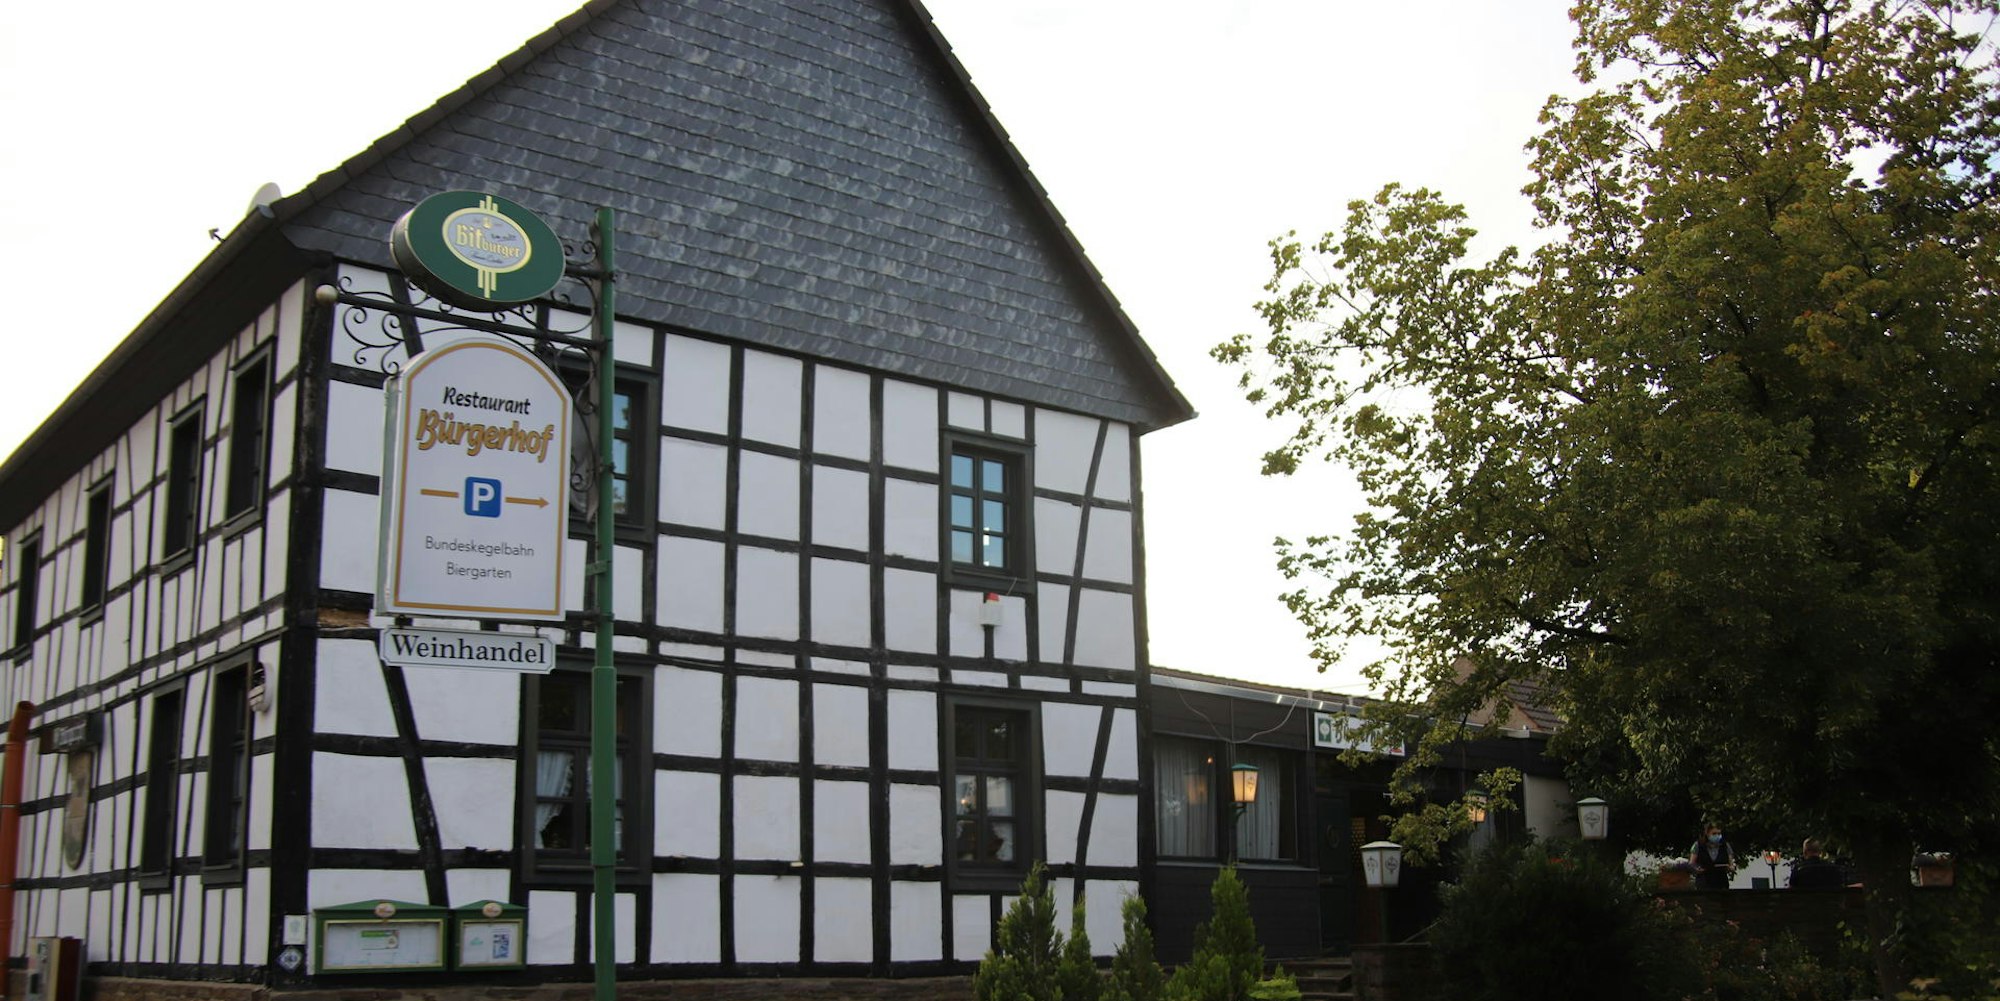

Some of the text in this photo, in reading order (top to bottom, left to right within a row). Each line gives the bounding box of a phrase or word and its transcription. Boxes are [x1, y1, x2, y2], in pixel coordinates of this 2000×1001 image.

[455, 223, 519, 258] Bitburger
[443, 386, 531, 415] Restaurant
[416, 408, 554, 463] Bürgerhof
[471, 482, 495, 511] P
[425, 536, 535, 558] Bundeskegelbahn
[446, 562, 512, 580] Biergarten
[391, 633, 546, 664] Weinhandel
